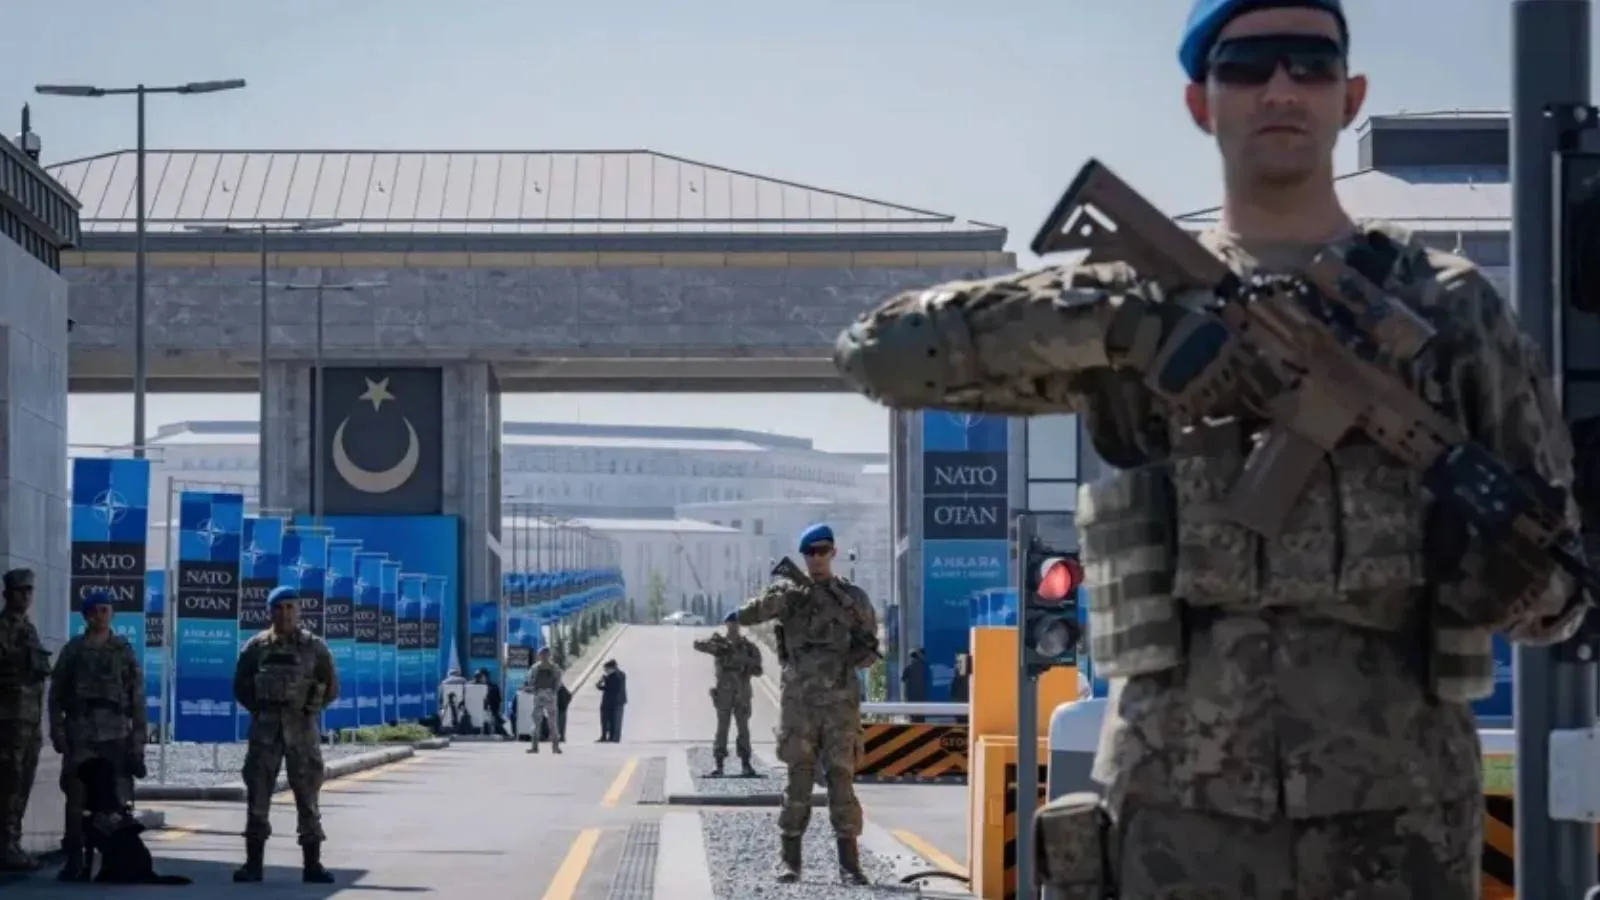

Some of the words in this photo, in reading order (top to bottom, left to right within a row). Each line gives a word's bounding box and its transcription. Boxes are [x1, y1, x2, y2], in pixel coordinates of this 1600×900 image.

[934, 466, 998, 485] NATO
[934, 506, 998, 525] OTAN
[80, 553, 136, 570] NATO
[931, 556, 1000, 568] ANKARA
[186, 571, 232, 585] NATO
[185, 596, 231, 610] OTAN
